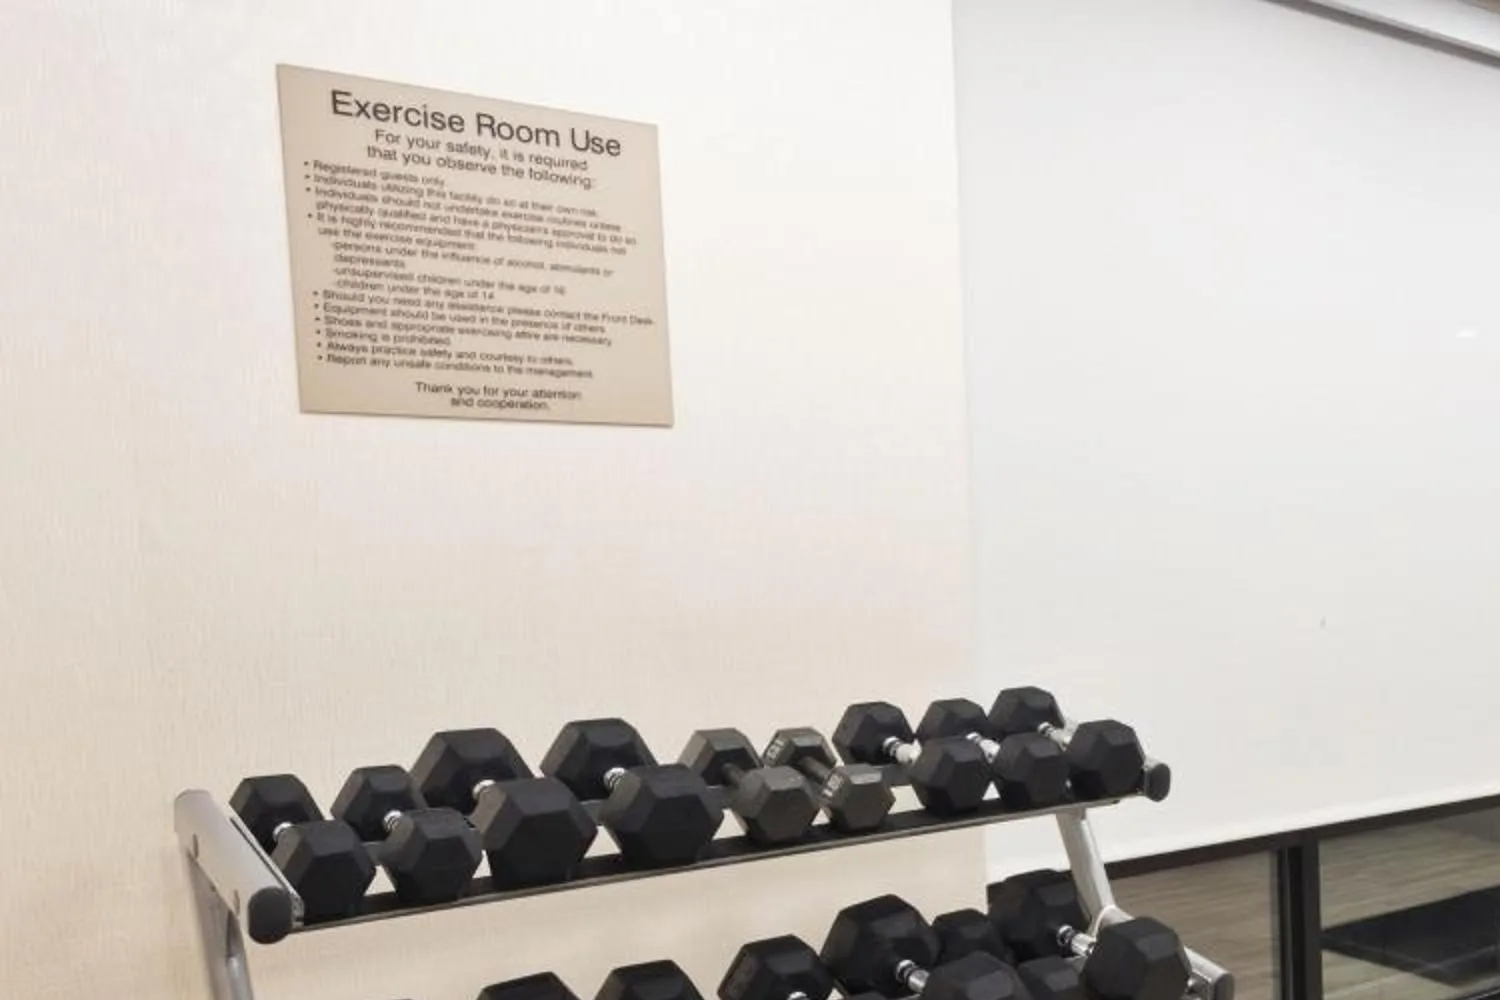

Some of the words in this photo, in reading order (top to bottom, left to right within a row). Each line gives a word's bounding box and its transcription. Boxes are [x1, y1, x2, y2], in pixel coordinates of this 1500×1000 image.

[331, 89, 464, 134] Exercise
[476, 112, 560, 148] Room
[571, 126, 620, 157] Use
[368, 145, 397, 161] that
[402, 152, 431, 168] you
[436, 154, 497, 174] observe
[501, 163, 524, 178] the
[375, 129, 400, 144] For
[407, 136, 440, 152] your
[500, 147, 508, 159] it
[513, 149, 524, 161] is
[529, 151, 587, 169] required
